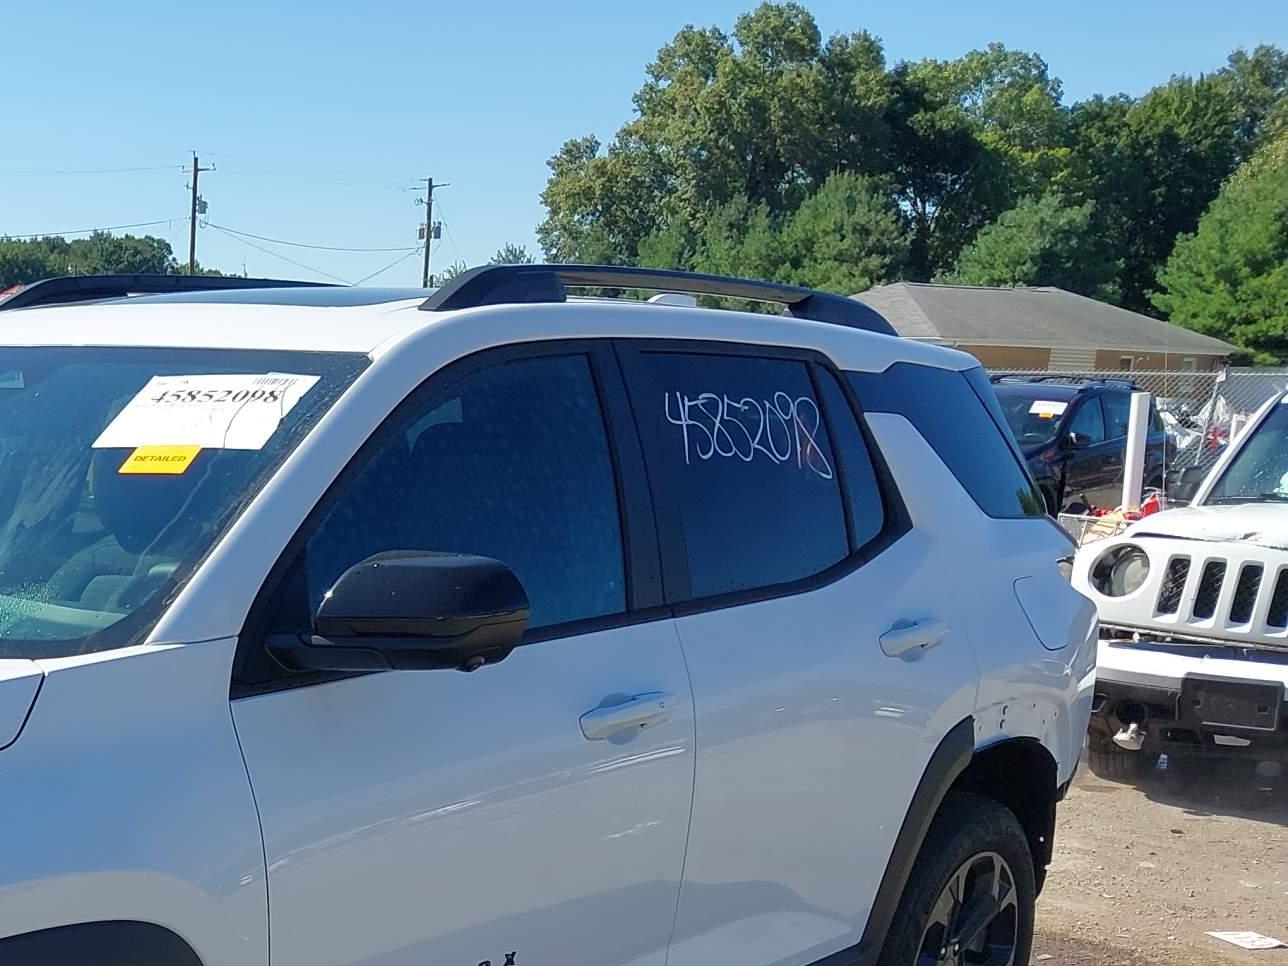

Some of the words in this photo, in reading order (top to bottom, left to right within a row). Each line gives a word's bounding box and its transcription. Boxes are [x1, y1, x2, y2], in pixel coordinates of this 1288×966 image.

[150, 388, 286, 404] 45852098
[664, 390, 834, 480] 45852098
[133, 454, 188, 463] DETAILED
